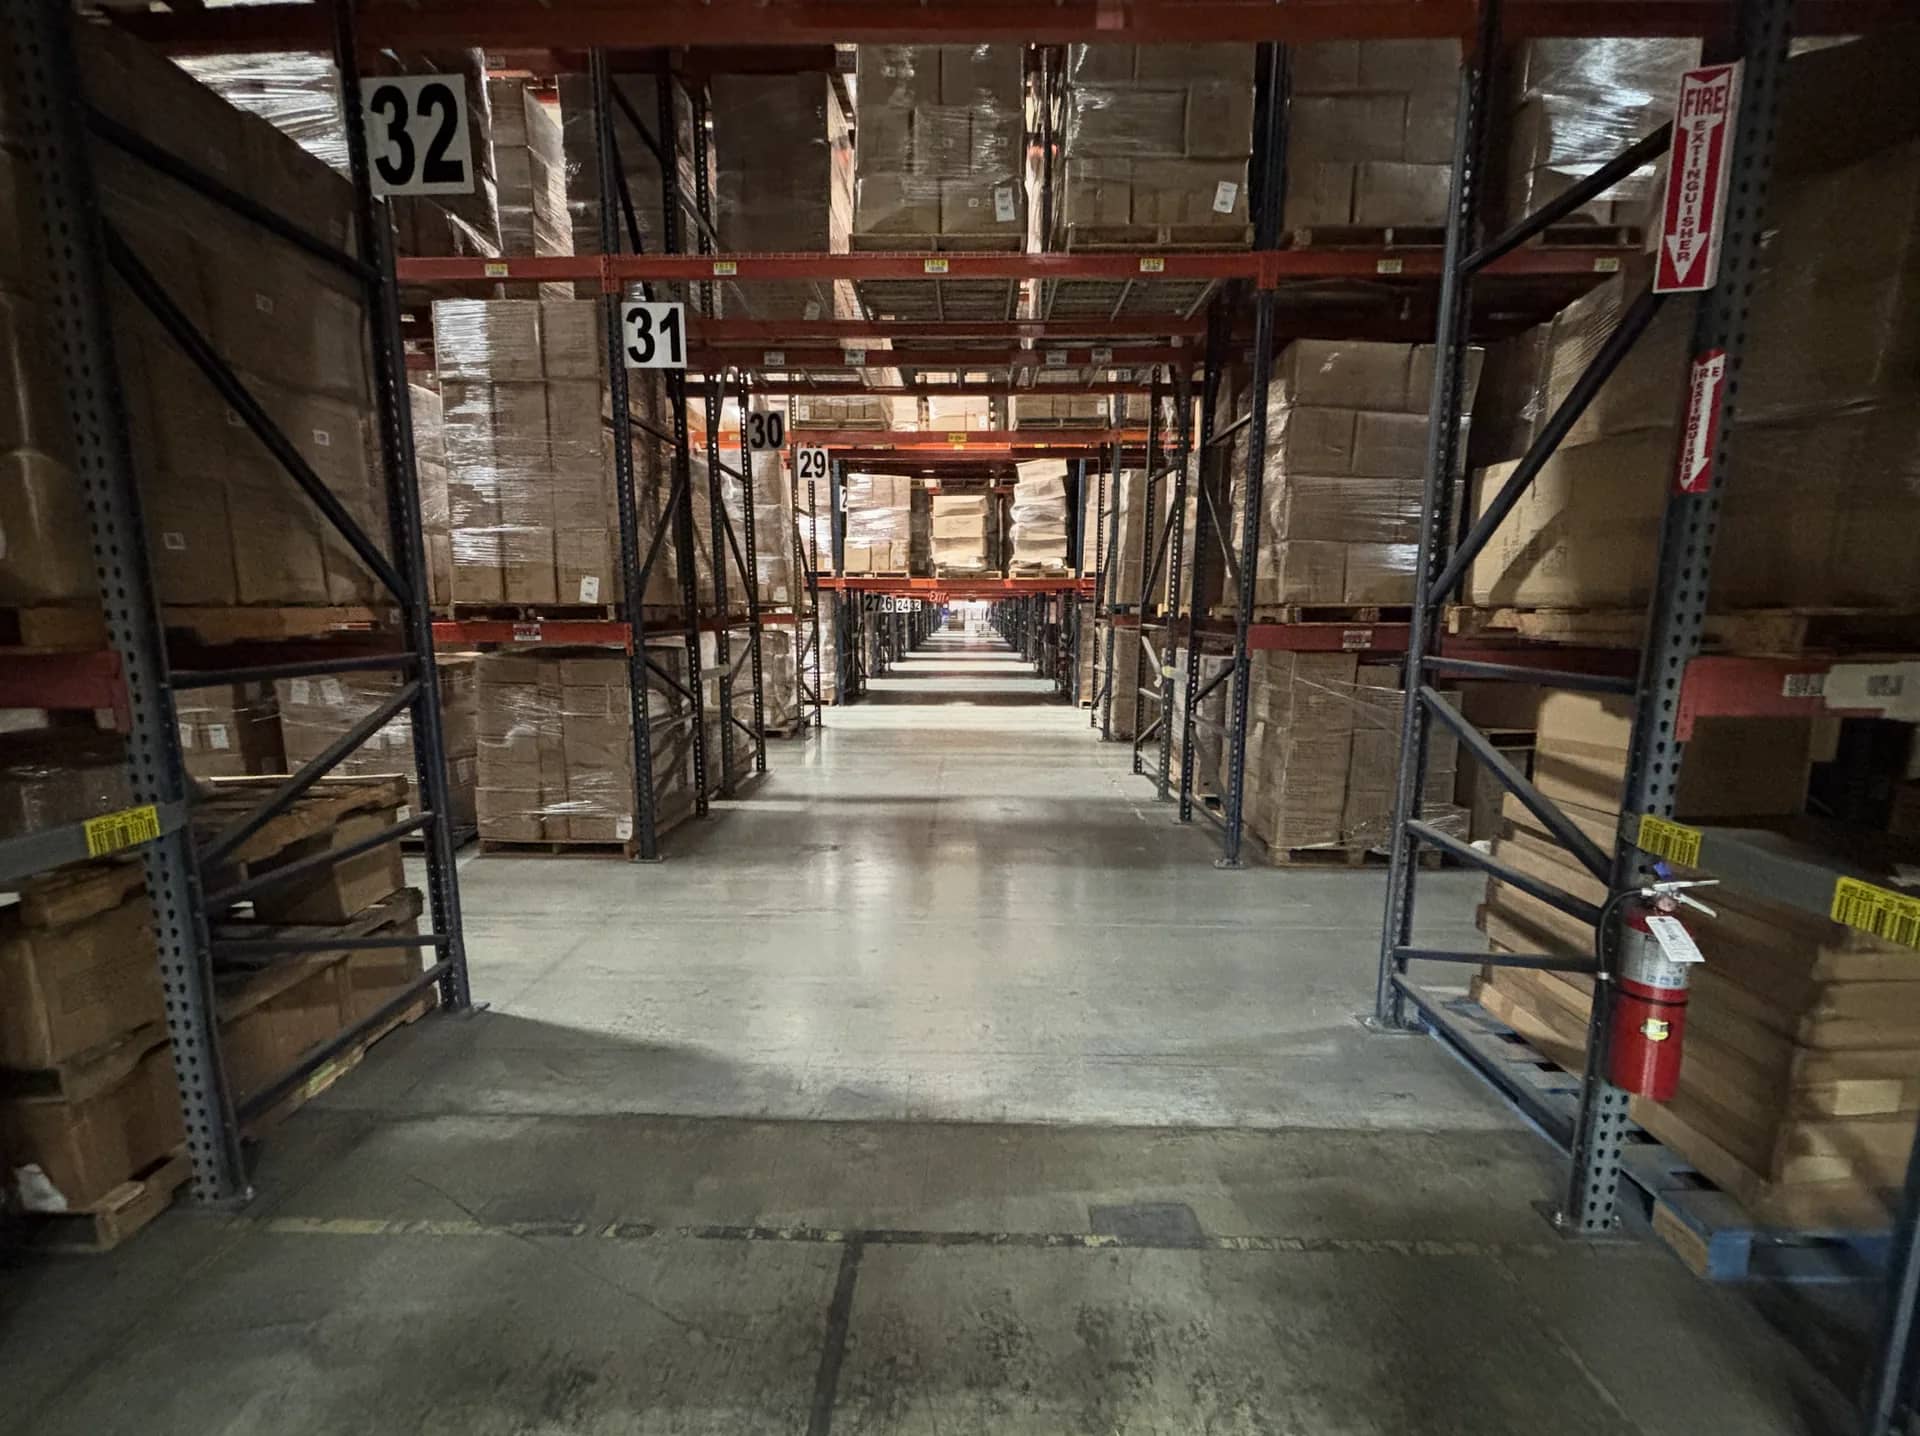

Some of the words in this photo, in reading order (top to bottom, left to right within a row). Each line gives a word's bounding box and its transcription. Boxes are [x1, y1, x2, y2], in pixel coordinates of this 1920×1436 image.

[1683, 86, 1727, 117] FIRE
[370, 83, 465, 186] 32
[1676, 119, 1707, 263] EXTINGUISHER
[626, 308, 683, 363] 31
[749, 413, 783, 449] 30
[1682, 381, 1705, 480] EXTINGUISHER
[800, 450, 826, 479] 29
[865, 594, 880, 611] 27
[897, 599, 908, 611] 24
